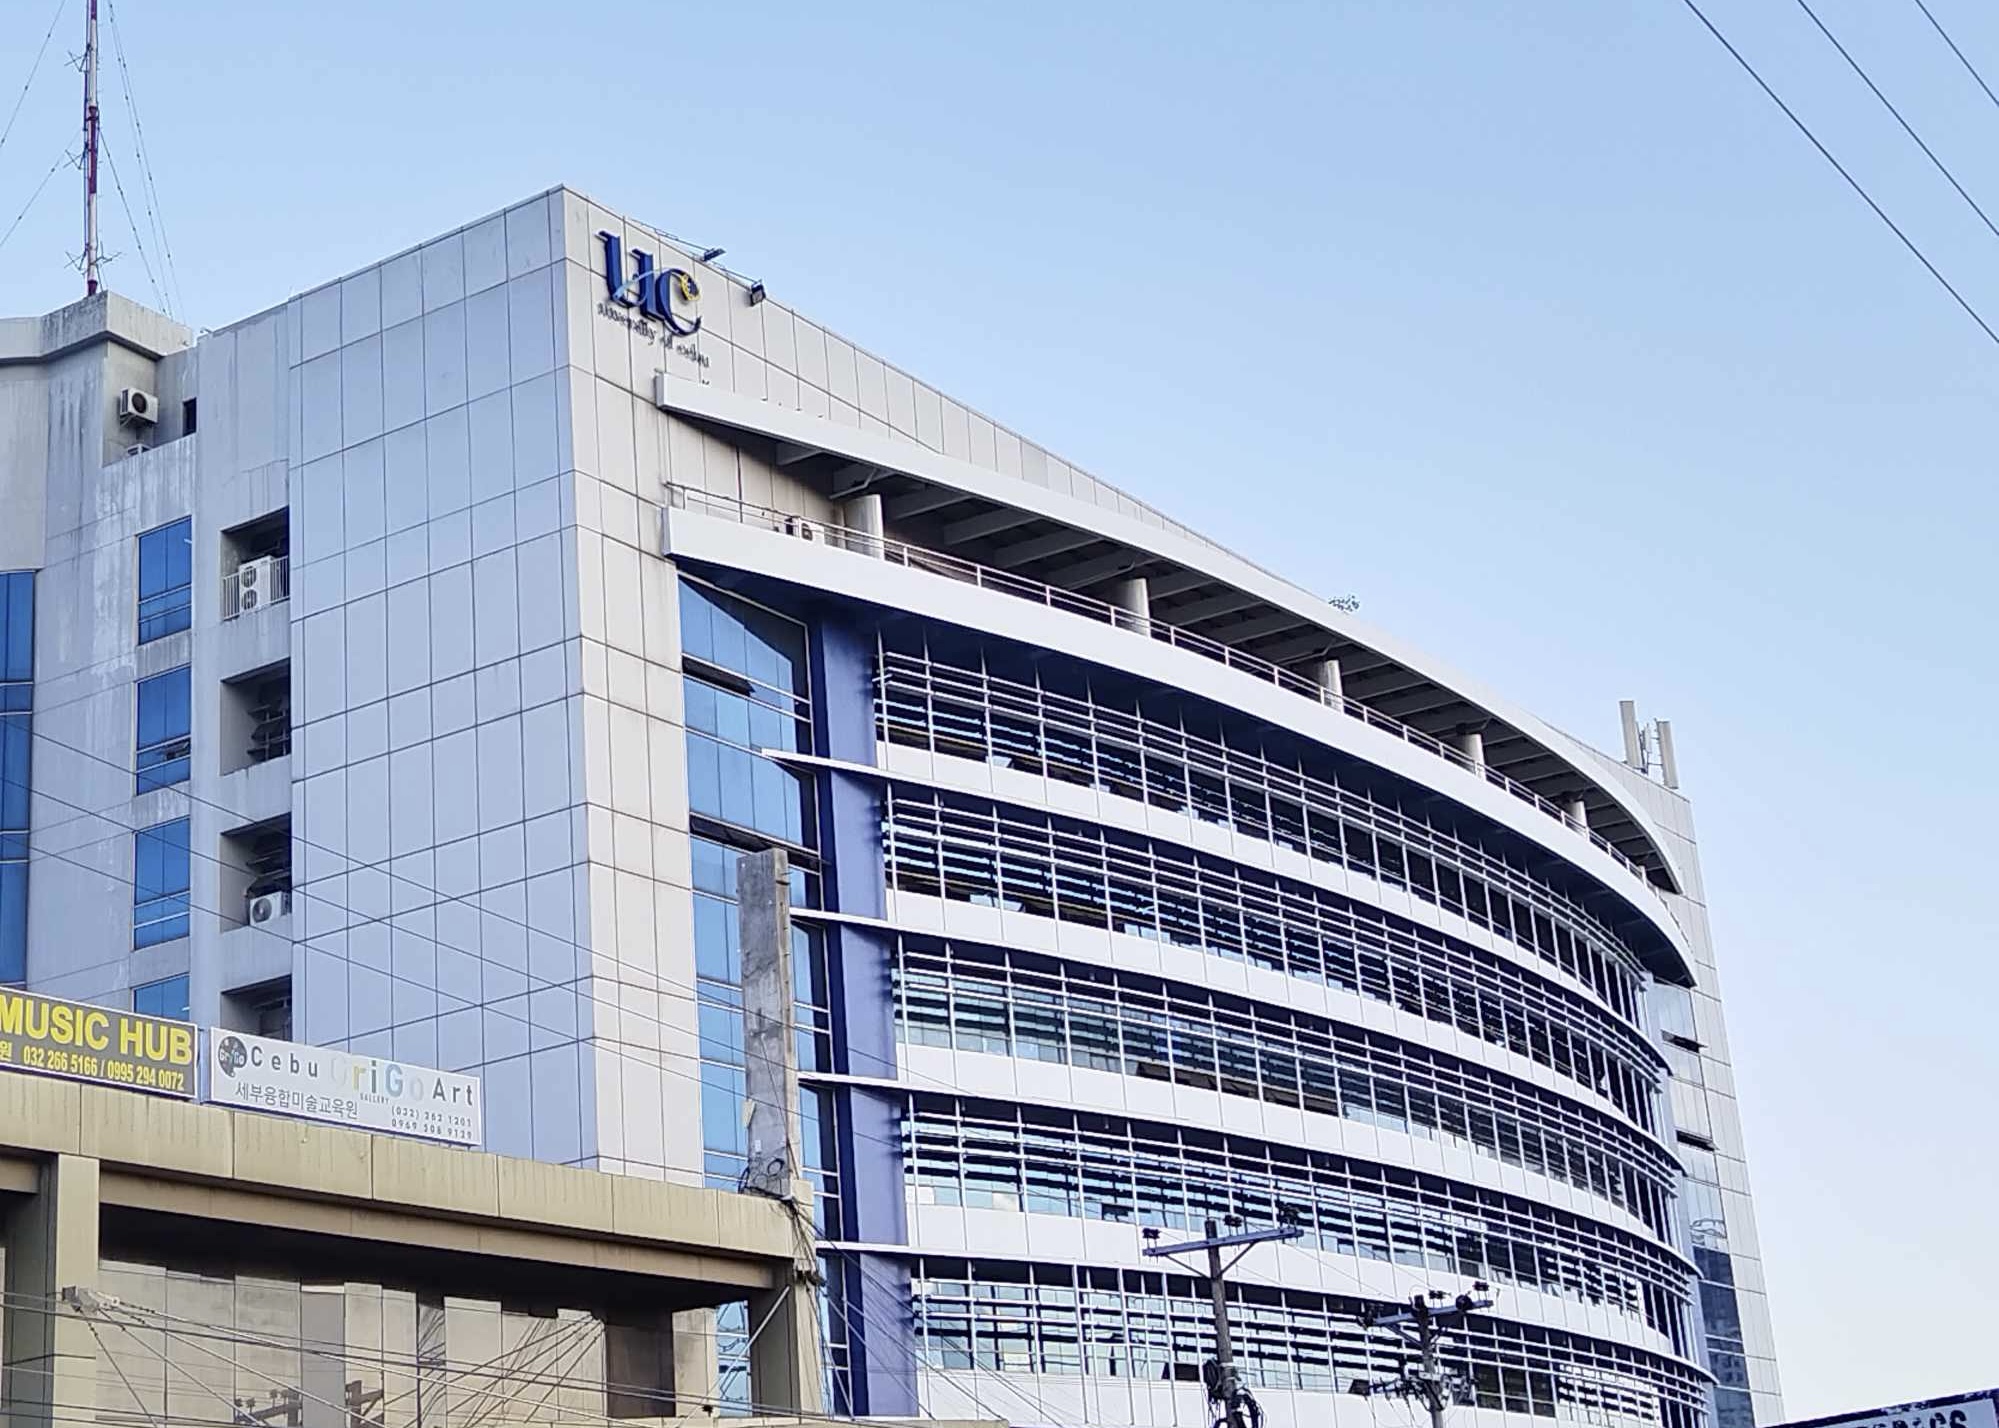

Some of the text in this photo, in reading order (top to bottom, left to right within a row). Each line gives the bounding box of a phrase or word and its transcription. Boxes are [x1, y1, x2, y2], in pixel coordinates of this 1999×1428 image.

[0, 994, 192, 1066] MUSIC HUB
[23, 1045, 45, 1067] 032
[47, 1050, 68, 1071] 266
[71, 1054, 98, 1077] 5166
[107, 1061, 134, 1082] 0995
[136, 1065, 156, 1086] 294
[159, 1069, 184, 1091] 0072
[250, 1045, 318, 1078] Cebu
[432, 1077, 473, 1106] Art
[235, 1081, 358, 1120] 세부융합미술교육원
